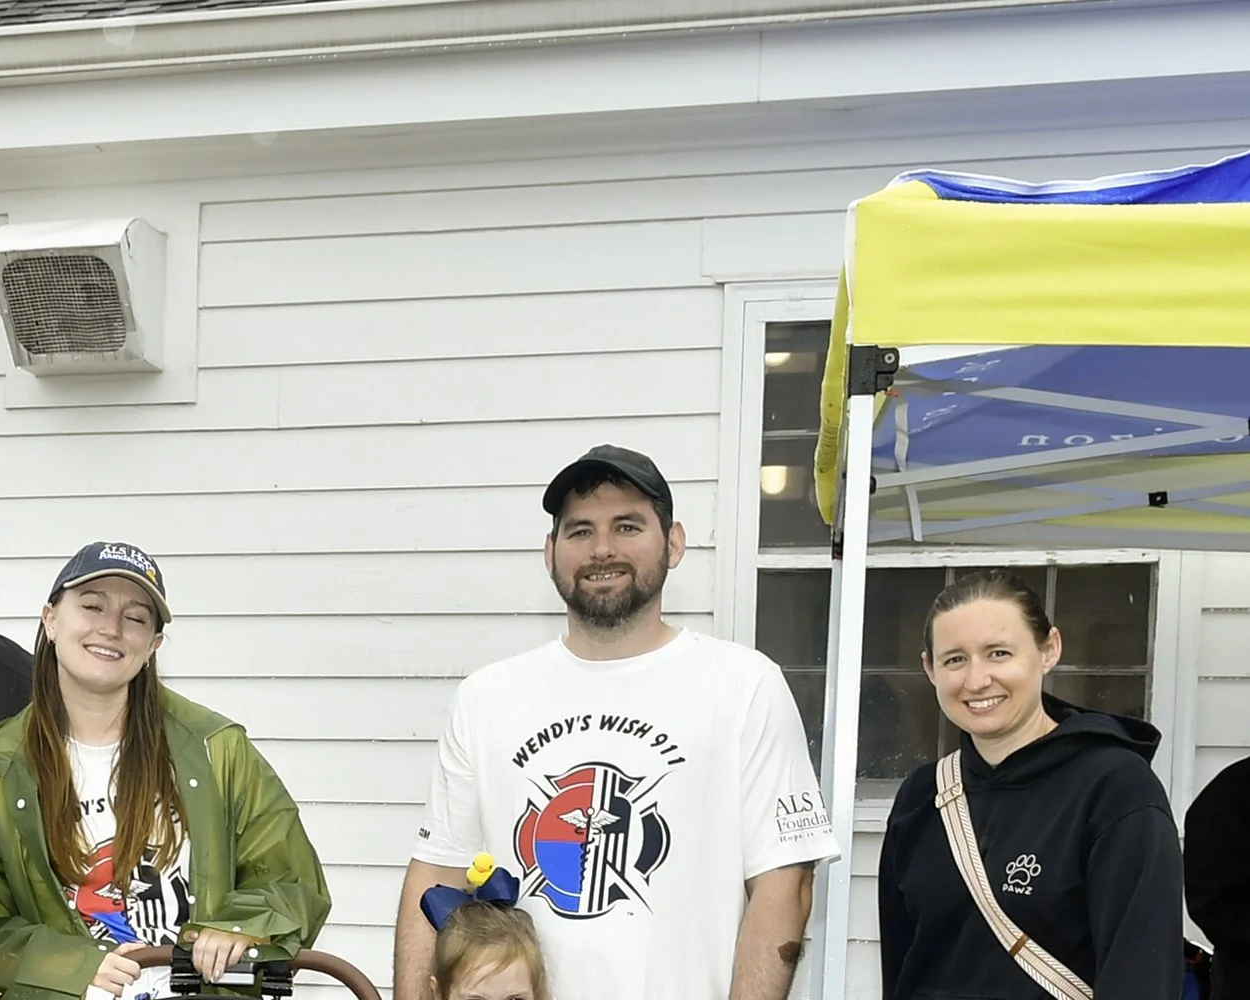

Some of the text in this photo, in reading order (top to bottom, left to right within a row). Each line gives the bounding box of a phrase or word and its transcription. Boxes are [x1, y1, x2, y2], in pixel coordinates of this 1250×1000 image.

[103, 546, 127, 555] ALS
[512, 714, 686, 769] WENDY'S WISH 911
[774, 791, 814, 818] ALS
[1002, 883, 1033, 896] PAWZ
